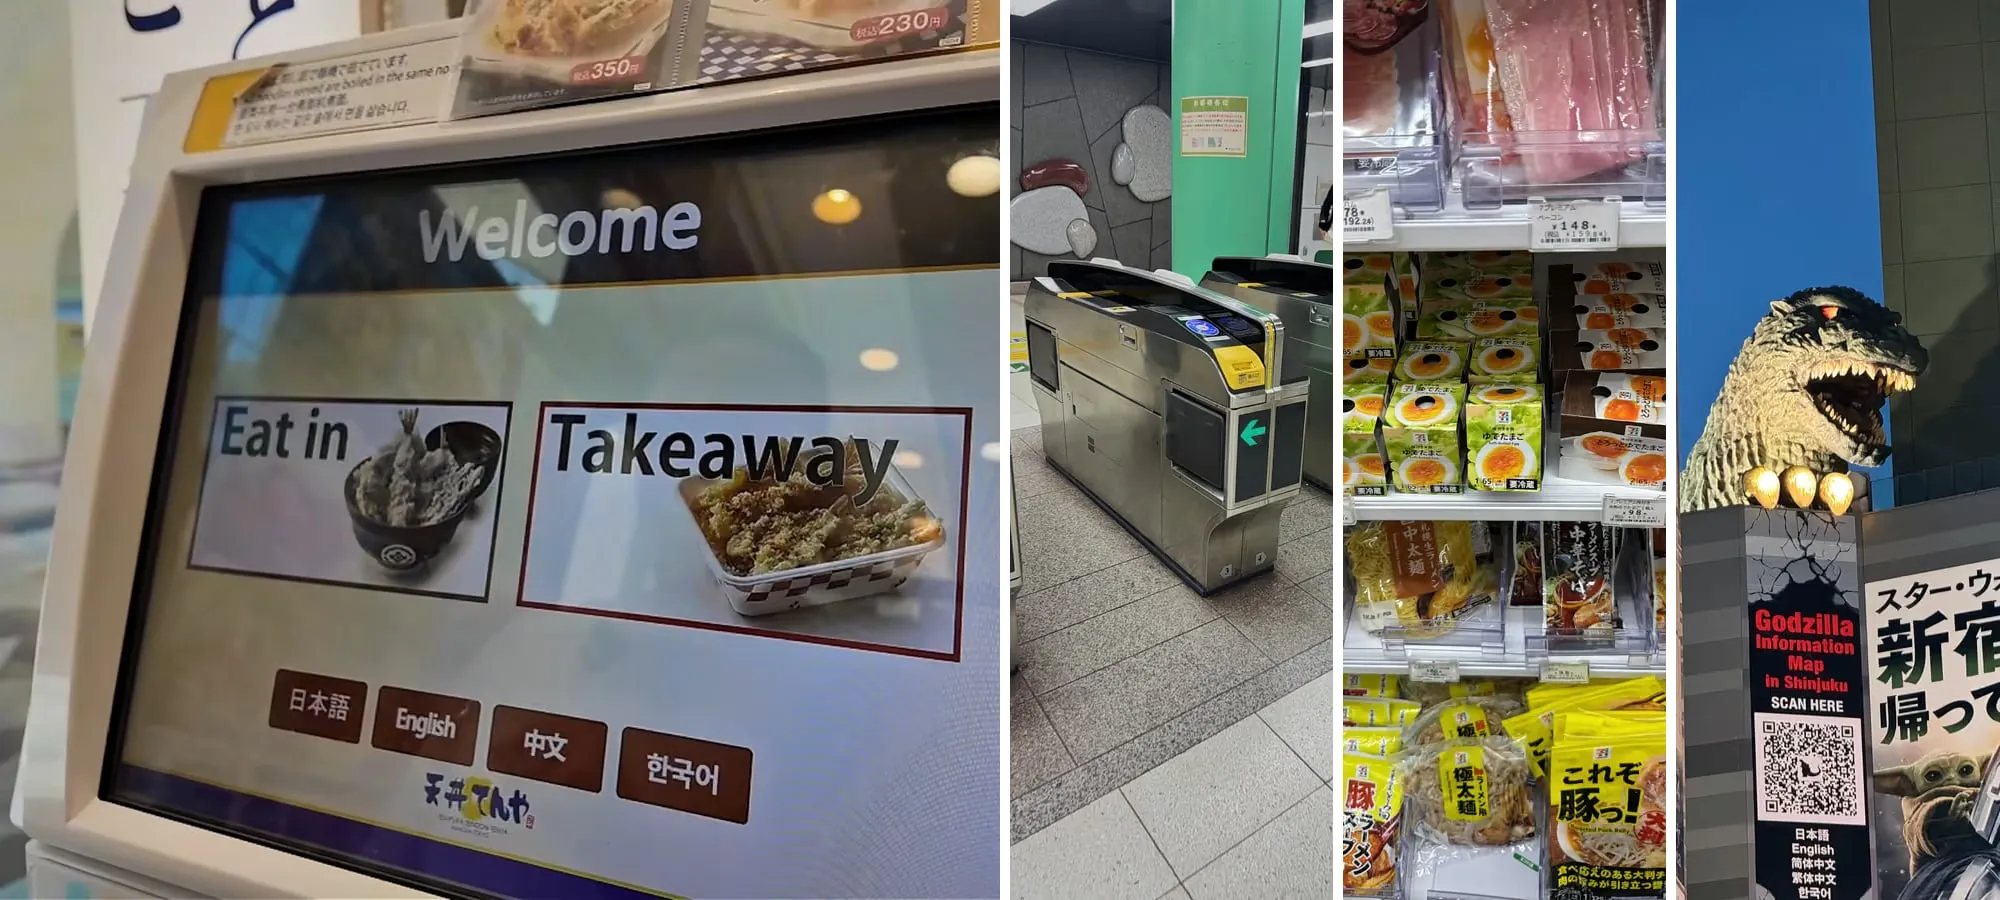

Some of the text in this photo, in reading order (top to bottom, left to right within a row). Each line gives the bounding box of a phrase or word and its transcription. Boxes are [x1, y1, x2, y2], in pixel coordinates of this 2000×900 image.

[386, 70, 404, 83] the
[406, 67, 433, 80] same
[419, 199, 702, 263] Welcome
[220, 405, 349, 461] Eat in
[1482, 432, 1525, 441] ゆでたまご
[551, 412, 899, 508] Takeaway
[1402, 449, 1443, 457] ゆでたまご
[1509, 480, 1535, 489] 要冷蔵
[1402, 526, 1426, 577] 中太麺
[1569, 525, 1588, 600] 中華そば
[1755, 608, 1854, 637] Godzilla
[1755, 634, 1855, 656] Information
[1877, 600, 2000, 690] 新宿
[1788, 655, 1824, 675] Map
[1765, 674, 1849, 694] in Shinjuku
[289, 688, 352, 722] 日本語
[1771, 696, 1844, 713] SCAN HERE
[1879, 682, 2000, 745] 帰って
[395, 707, 457, 739] English
[523, 728, 569, 762] 中文
[647, 752, 720, 796] 한국어
[1562, 761, 1642, 785] これぞ
[1346, 779, 1376, 811] 豚
[1453, 766, 1477, 816] 極太麺
[1353, 813, 1374, 876] ラーメン
[1791, 842, 1835, 857] English
[1795, 828, 1830, 842] 日本語
[1557, 874, 1665, 890] 肉の旨みが引き立つ醤
[1791, 871, 1837, 886] 繁体中文
[1798, 886, 1832, 900] 한국어
